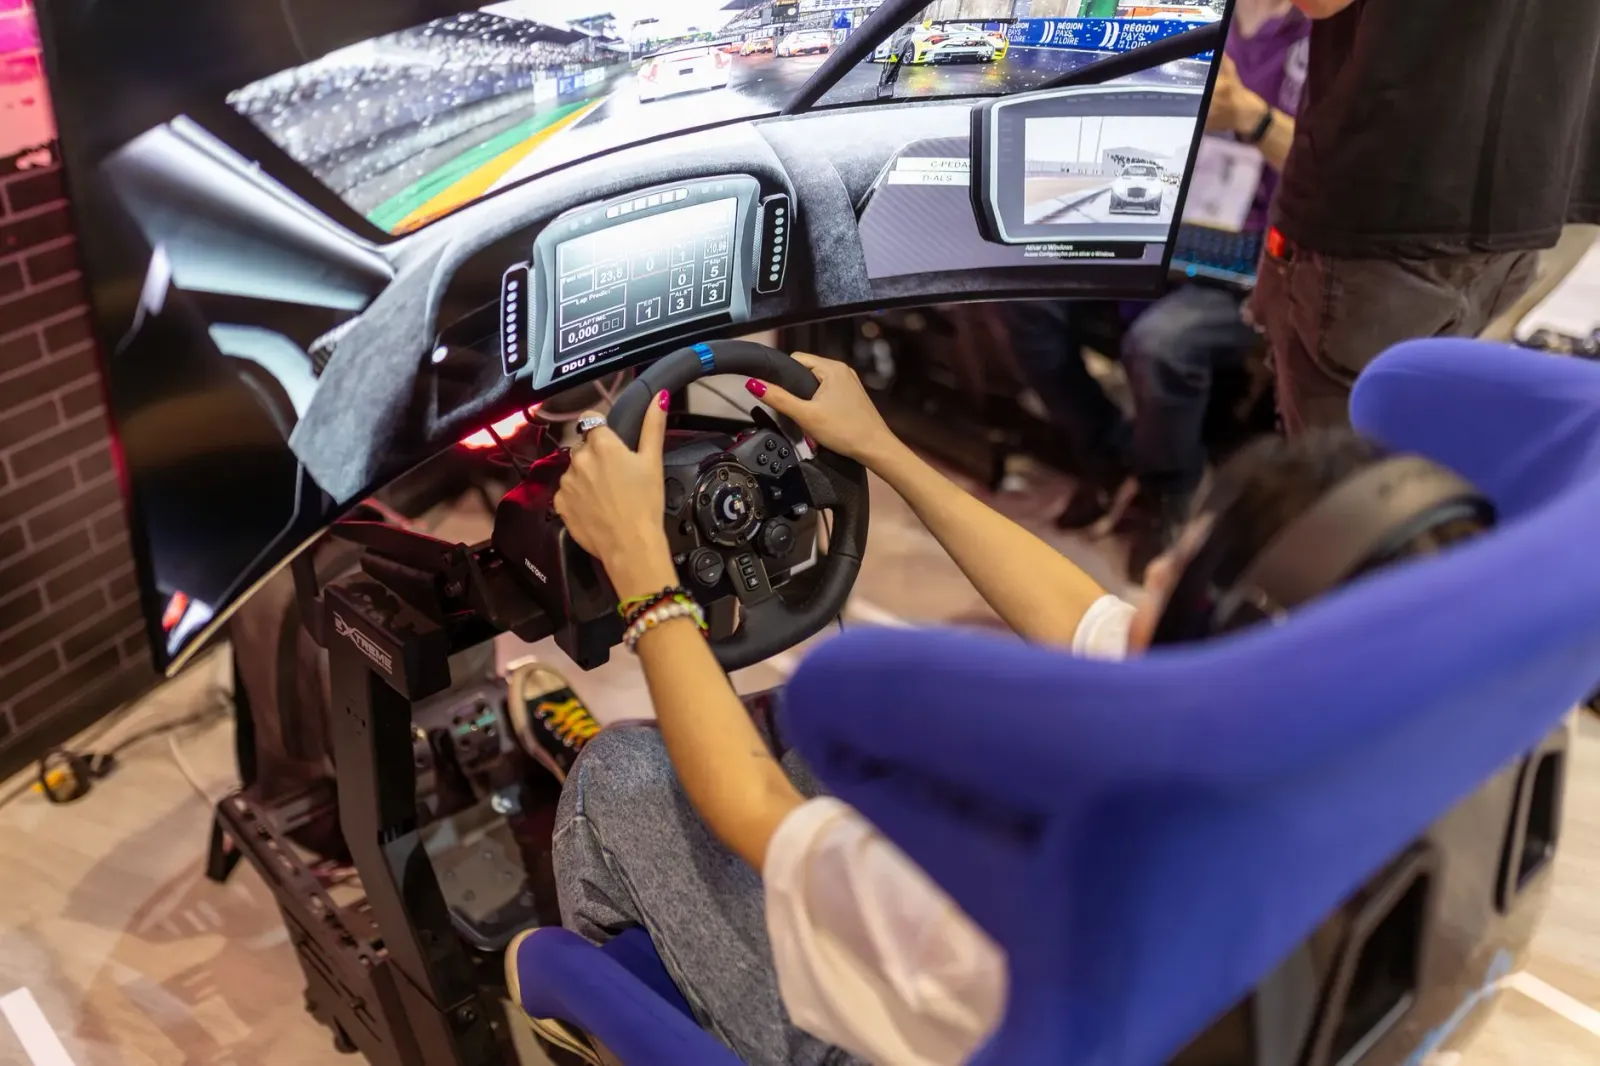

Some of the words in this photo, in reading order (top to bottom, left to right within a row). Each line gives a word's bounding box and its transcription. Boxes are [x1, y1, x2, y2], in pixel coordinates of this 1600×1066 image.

[1057, 21, 1083, 30] RÉGION
[1123, 22, 1159, 33] RÉGION
[1055, 29, 1073, 37] PAYS
[1120, 32, 1145, 41] PAYS
[1060, 36, 1080, 45] LOIRE
[645, 257, 655, 272] 0
[710, 265, 719, 278] 5
[678, 273, 687, 286] 0
[708, 289, 718, 302] 3
[676, 298, 685, 310] 3
[645, 306, 652, 319] 1
[579, 314, 607, 328] LAPTIME
[568, 323, 599, 344] 0,000
[562, 357, 586, 374] DDU
[588, 354, 596, 363] 9
